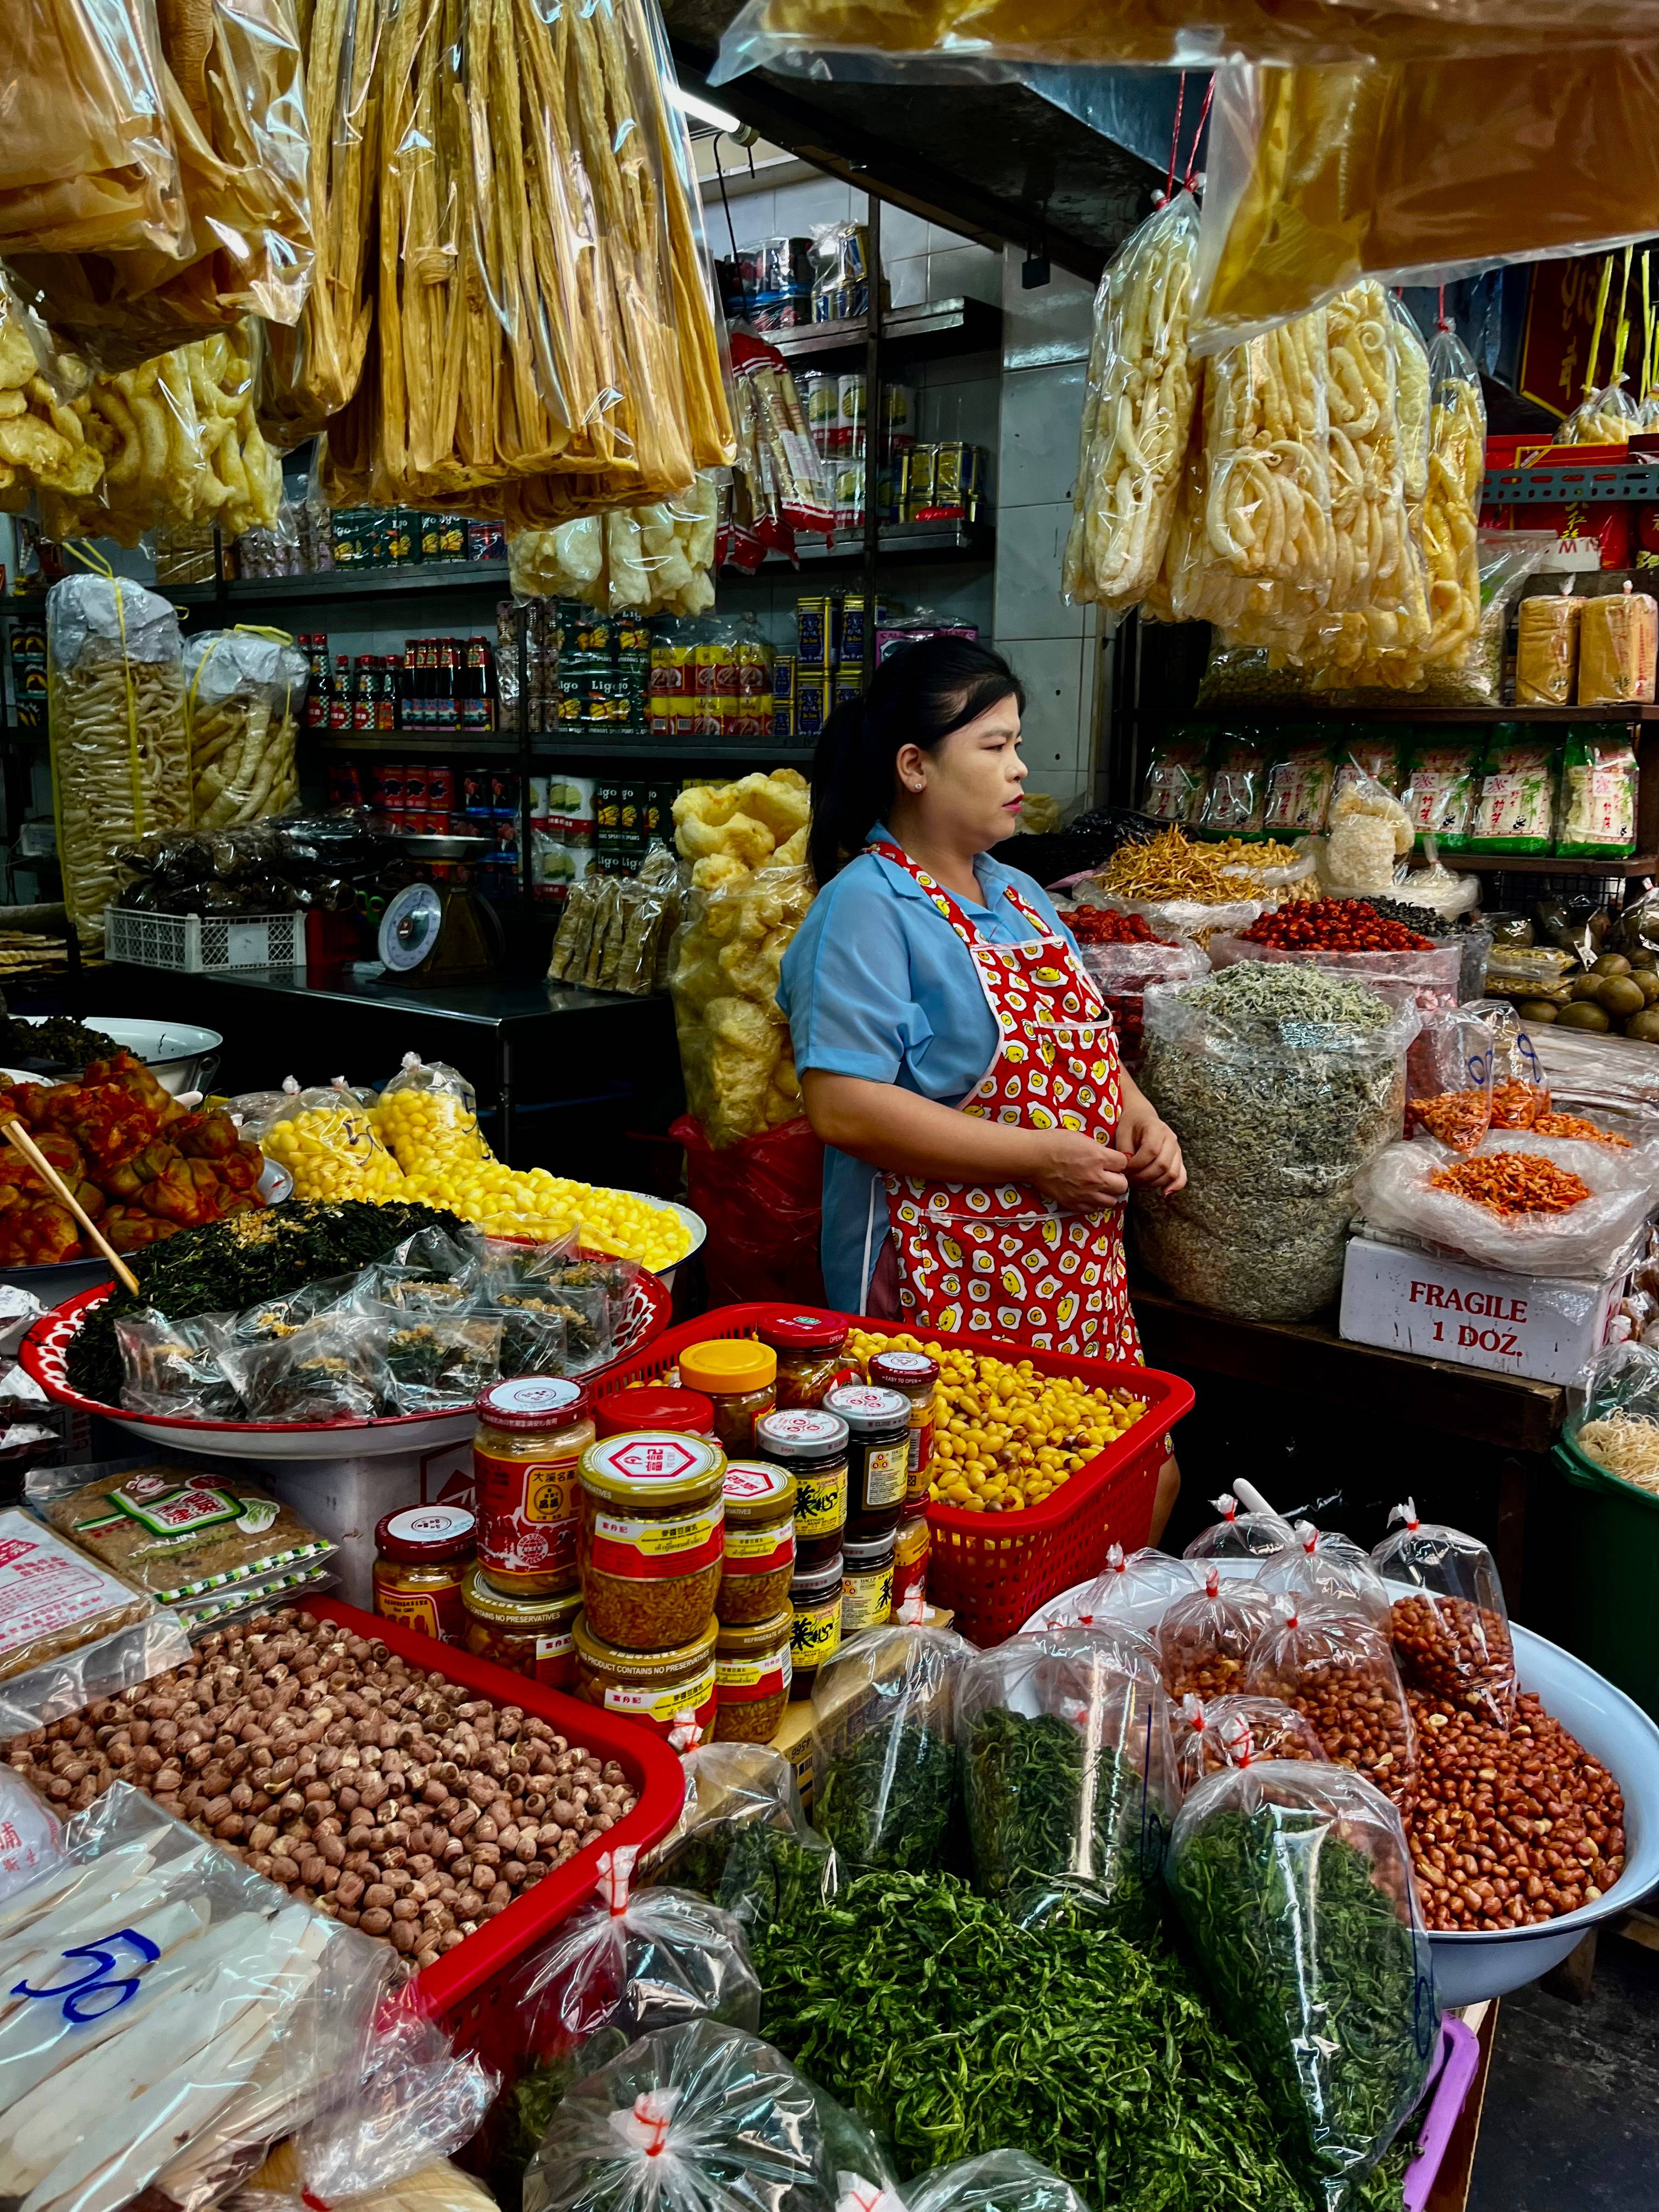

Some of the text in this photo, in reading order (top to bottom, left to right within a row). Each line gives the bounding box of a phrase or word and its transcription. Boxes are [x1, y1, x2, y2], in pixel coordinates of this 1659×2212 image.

[1409, 1280, 1528, 1324] FRAGILE
[1432, 1321, 1523, 1358] 1 DOZ.
[495, 1614, 505, 1622] NO
[506, 1611, 561, 1624] PRESERVATIVES
[588, 1655, 616, 1672] PRODUCT
[617, 1665, 653, 1675] CONTAINS
[653, 1666, 665, 1674] NO
[665, 1648, 710, 1673] PRESERVATIVES
